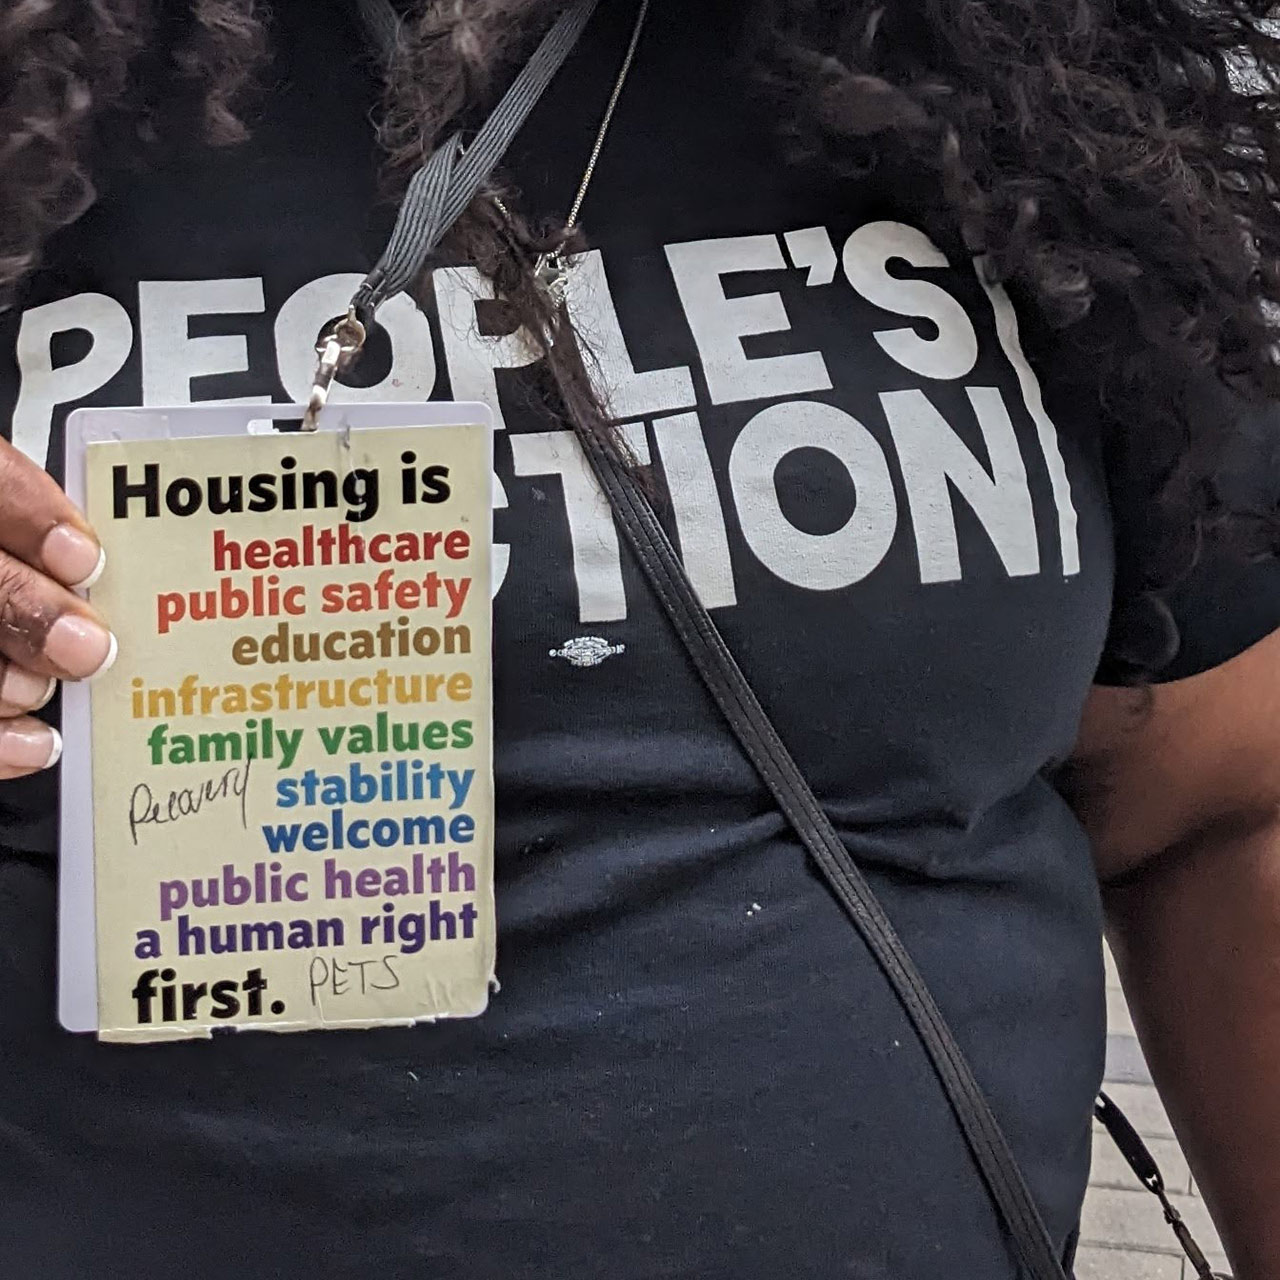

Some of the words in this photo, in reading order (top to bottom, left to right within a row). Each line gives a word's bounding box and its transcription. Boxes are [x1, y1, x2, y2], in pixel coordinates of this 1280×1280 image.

[112, 456, 379, 523] Housing
[401, 451, 451, 504] is
[214, 523, 470, 571] healthcare
[158, 575, 305, 636] public
[322, 569, 472, 618] safety
[232, 616, 471, 665] education
[132, 670, 472, 718] infrastructure
[147, 718, 304, 771] family
[318, 711, 473, 755] values
[276, 759, 475, 810] stability
[262, 809, 475, 853] welcome
[160, 862, 308, 921] public
[325, 852, 475, 899] health
[135, 930, 162, 959] a
[178, 915, 344, 956] human
[361, 900, 478, 954] right
[131, 968, 285, 1024] first.
[309, 954, 399, 1006] PETS
